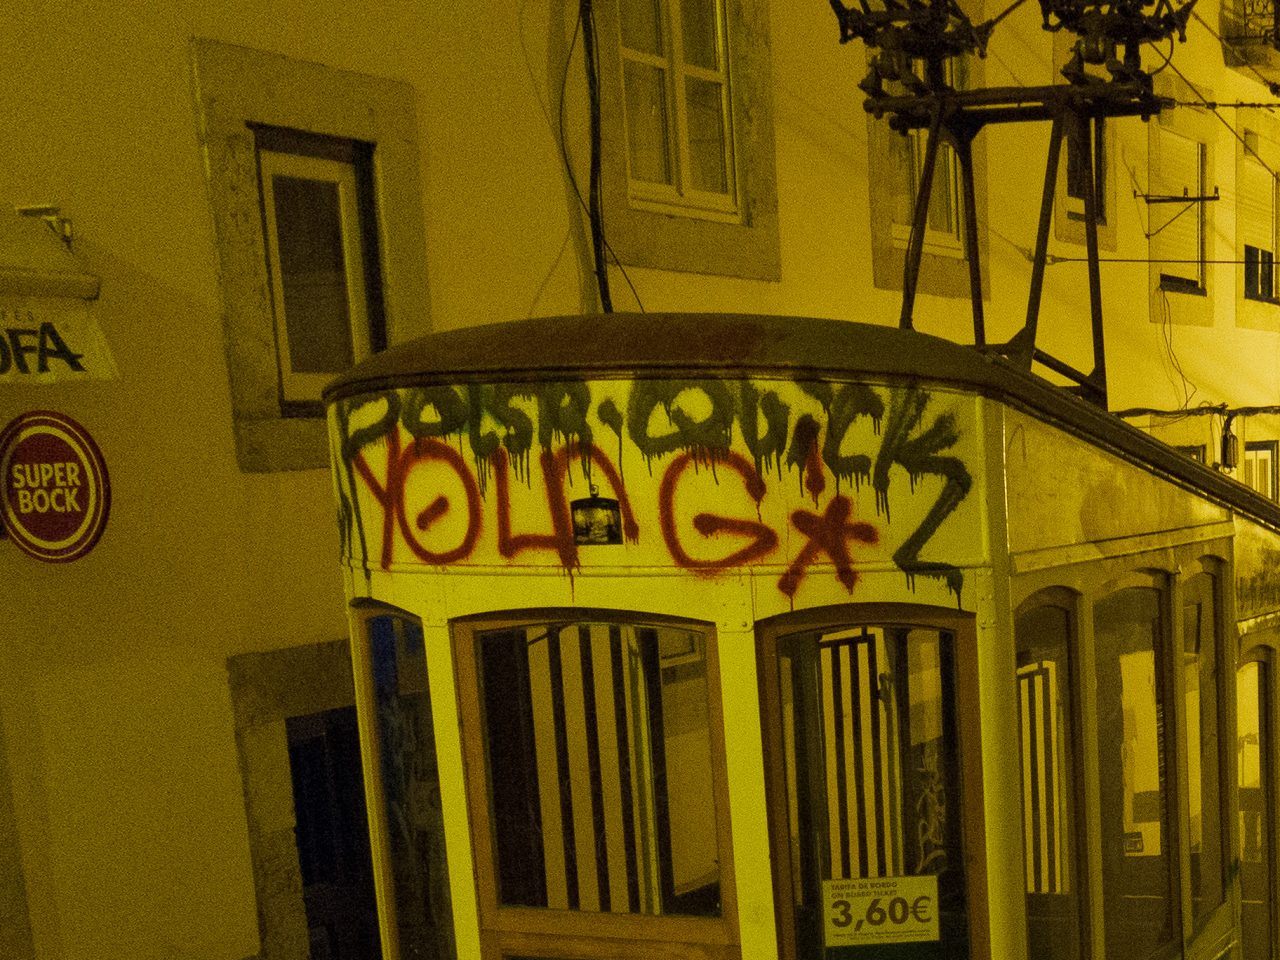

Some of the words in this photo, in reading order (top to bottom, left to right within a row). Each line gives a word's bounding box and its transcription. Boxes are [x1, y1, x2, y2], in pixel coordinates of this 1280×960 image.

[12, 462, 82, 488] SUPER
[18, 488, 82, 514] BOCK
[831, 895, 933, 932] 3,60€
